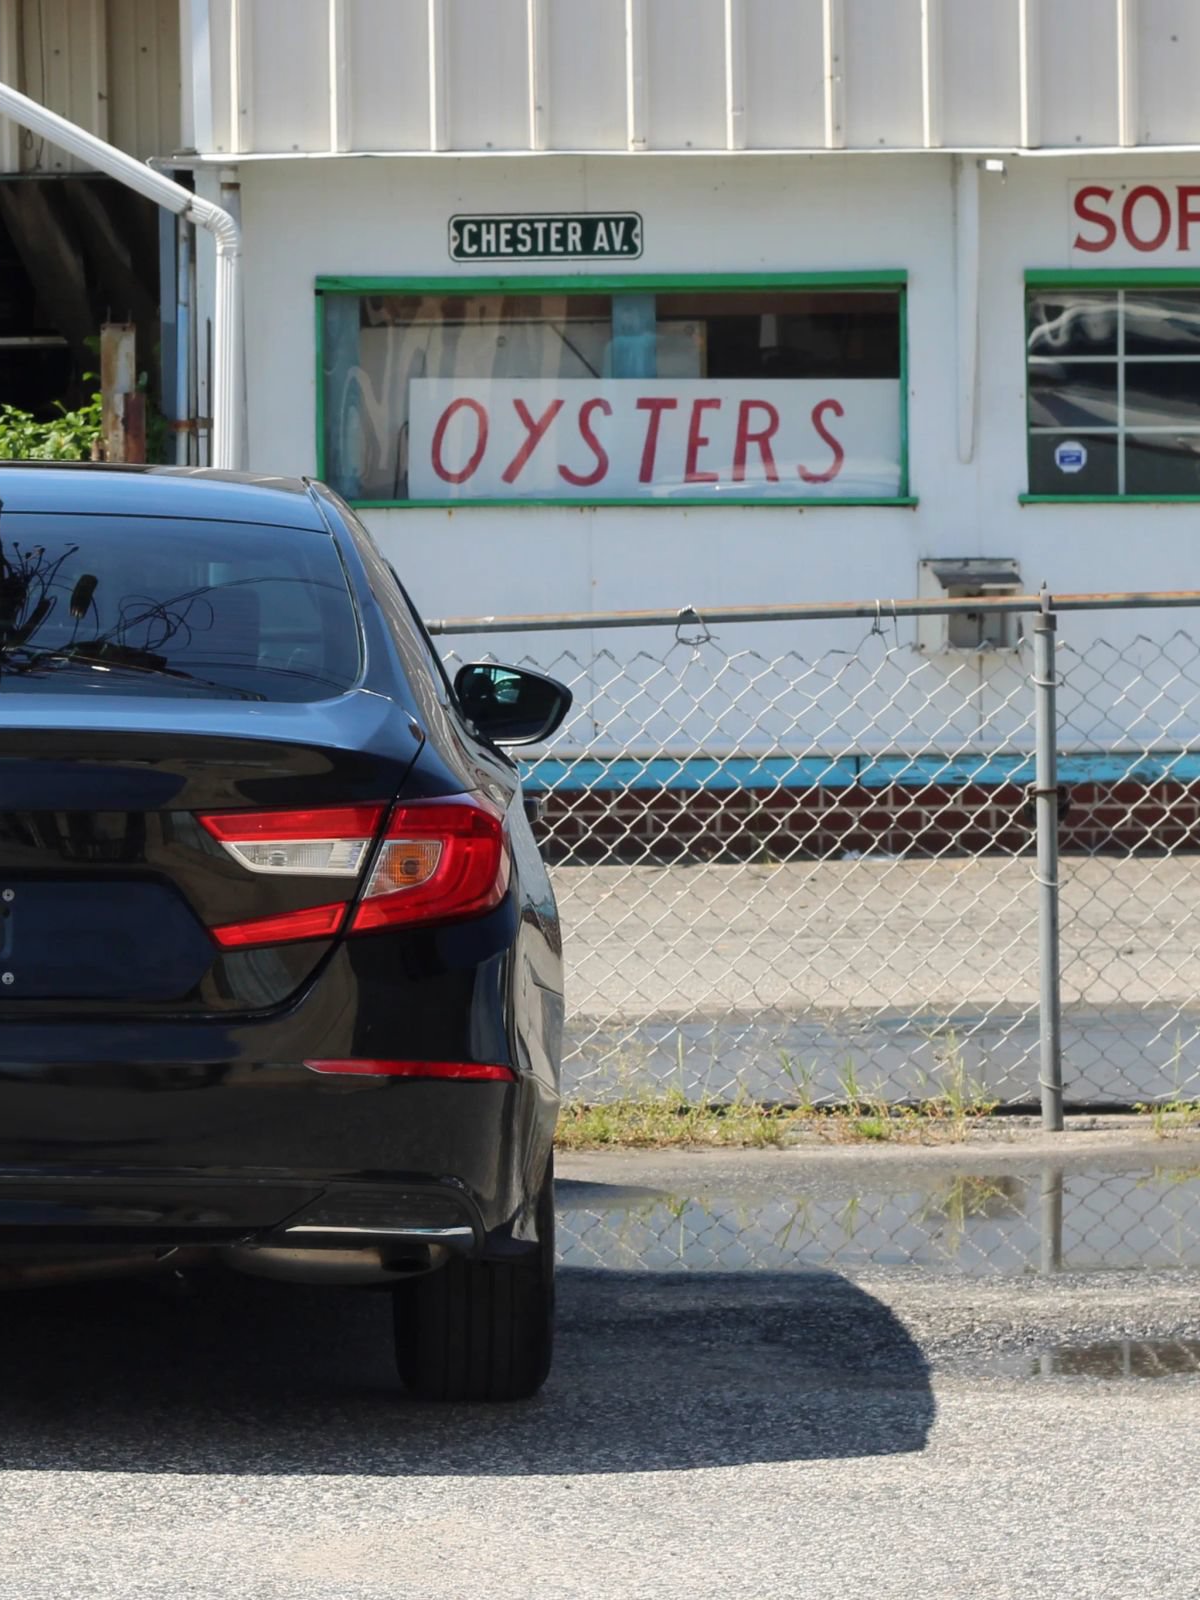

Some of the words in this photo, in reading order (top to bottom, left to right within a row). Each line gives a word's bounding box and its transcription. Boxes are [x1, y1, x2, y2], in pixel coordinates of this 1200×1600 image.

[462, 222, 582, 254] CHESTER
[593, 221, 629, 252] AV.
[431, 397, 845, 486] OYSTERS
